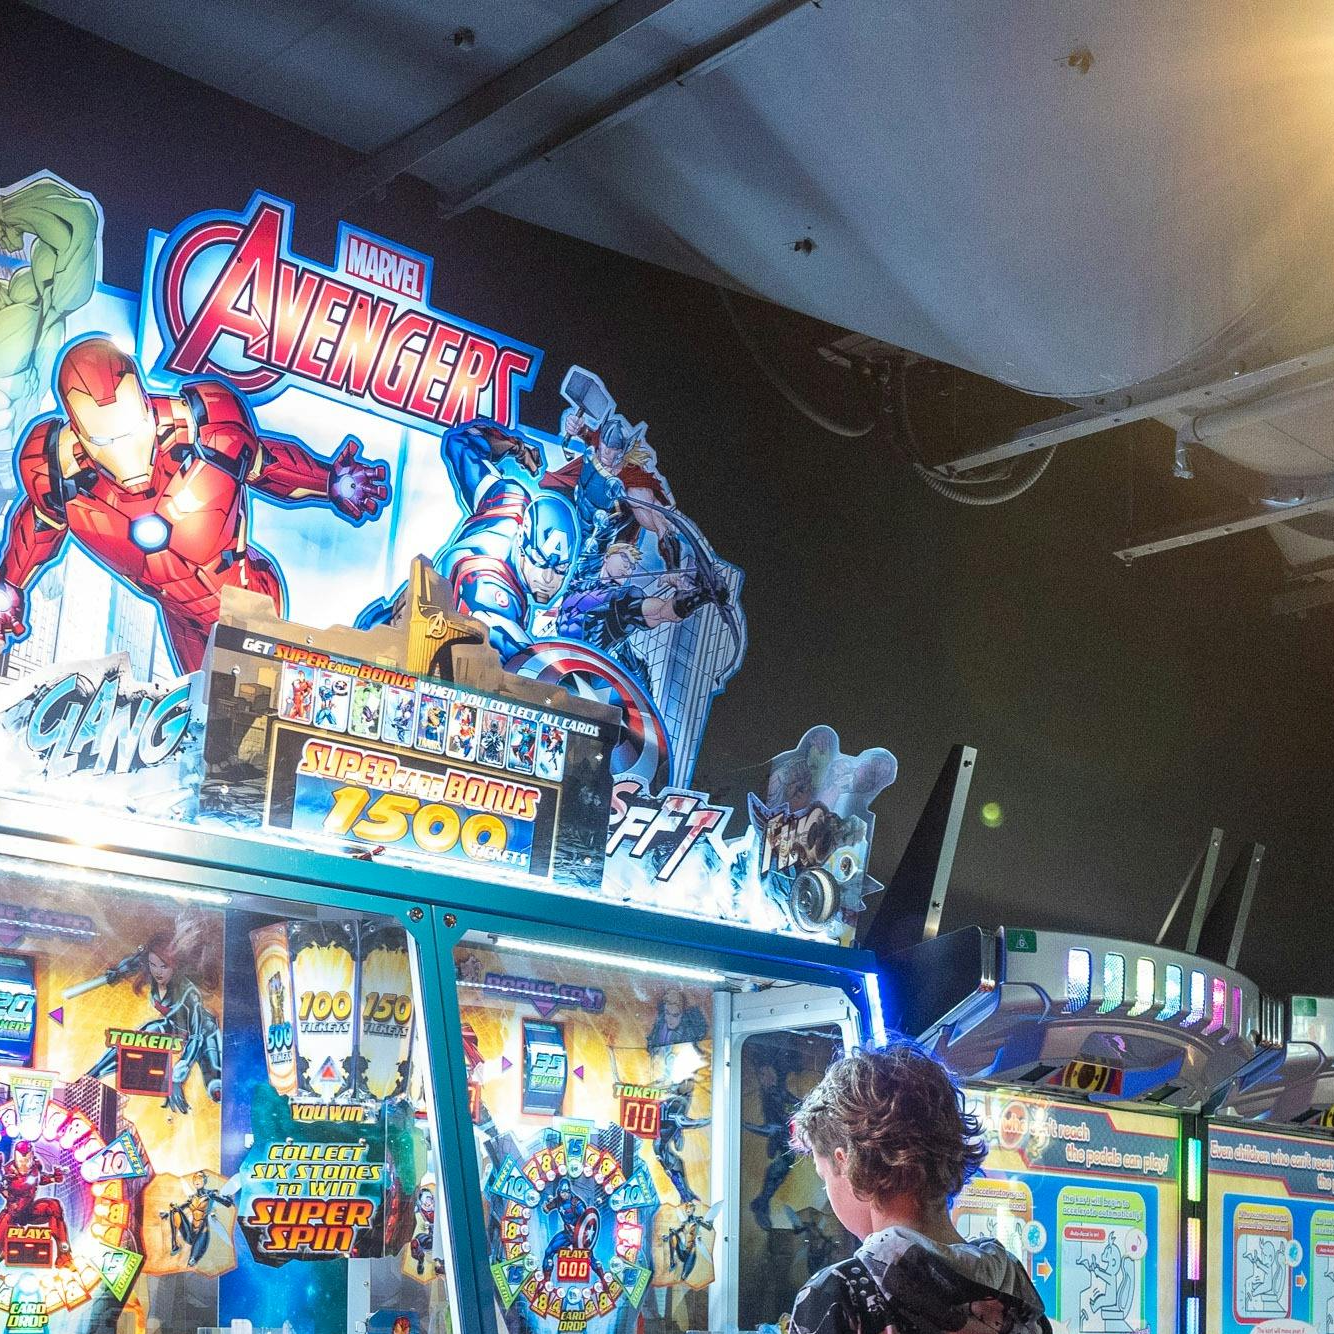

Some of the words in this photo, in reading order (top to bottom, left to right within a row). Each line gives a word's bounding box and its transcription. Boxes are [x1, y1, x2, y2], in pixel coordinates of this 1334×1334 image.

[347, 237, 424, 298] MARVEL
[172, 205, 532, 430] AVENGERS
[242, 637, 273, 655] GET
[274, 643, 330, 670] SUPER
[327, 660, 359, 675] CARD
[358, 665, 418, 691] BONUS
[419, 681, 456, 700] WHEN
[460, 691, 488, 708] YOU
[488, 697, 538, 722] COLLECT
[538, 710, 561, 728] ALL
[561, 718, 601, 738] CARDS
[26, 675, 192, 776] CLANG
[300, 741, 398, 789] SUPER
[443, 771, 541, 819] BONUS
[322, 785, 508, 863] 1500
[470, 843, 529, 868] TICKETS
[299, 991, 353, 1021] 100
[362, 991, 413, 1024] 150
[300, 1021, 350, 1033] TICKETS
[363, 1022, 409, 1037] TICKETS
[109, 1029, 185, 1051] TOKENS
[531, 1052, 566, 1075] 35
[291, 1104, 328, 1120] YOU
[328, 1104, 364, 1122] WIN
[624, 1102, 657, 1133] 00
[1003, 1115, 1025, 1134] who
[1058, 1122, 1090, 1142] reach
[121, 1136, 147, 1176] TICKETS
[268, 1144, 365, 1161] COLLECT
[568, 1139, 584, 1155] 15
[1210, 1139, 1234, 1160] Even
[1234, 1143, 1270, 1163] children
[1271, 1149, 1289, 1167] who
[1291, 1152, 1311, 1170] can't
[102, 1150, 129, 1175] 10
[1065, 1143, 1085, 1163] the
[1086, 1147, 1122, 1168] pedals
[1123, 1157, 1143, 1169] can
[1144, 1153, 1169, 1176] play!
[251, 1163, 293, 1179] SIX
[295, 1164, 384, 1180] STONES
[1317, 1174, 1332, 1189] the
[277, 1184, 303, 1196] TO
[310, 1181, 357, 1196] WIN
[506, 1175, 524, 1194] 10
[250, 1200, 373, 1226] SUPER
[7, 1227, 53, 1240] PLAYS
[266, 1227, 355, 1251] SPIN
[559, 1250, 590, 1258] PLAYS
[558, 1261, 589, 1278] 000
[10, 1302, 48, 1315] CARD
[560, 1312, 586, 1322] CARD
[7, 1314, 50, 1328] DROP
[559, 1321, 587, 1332] DROP
